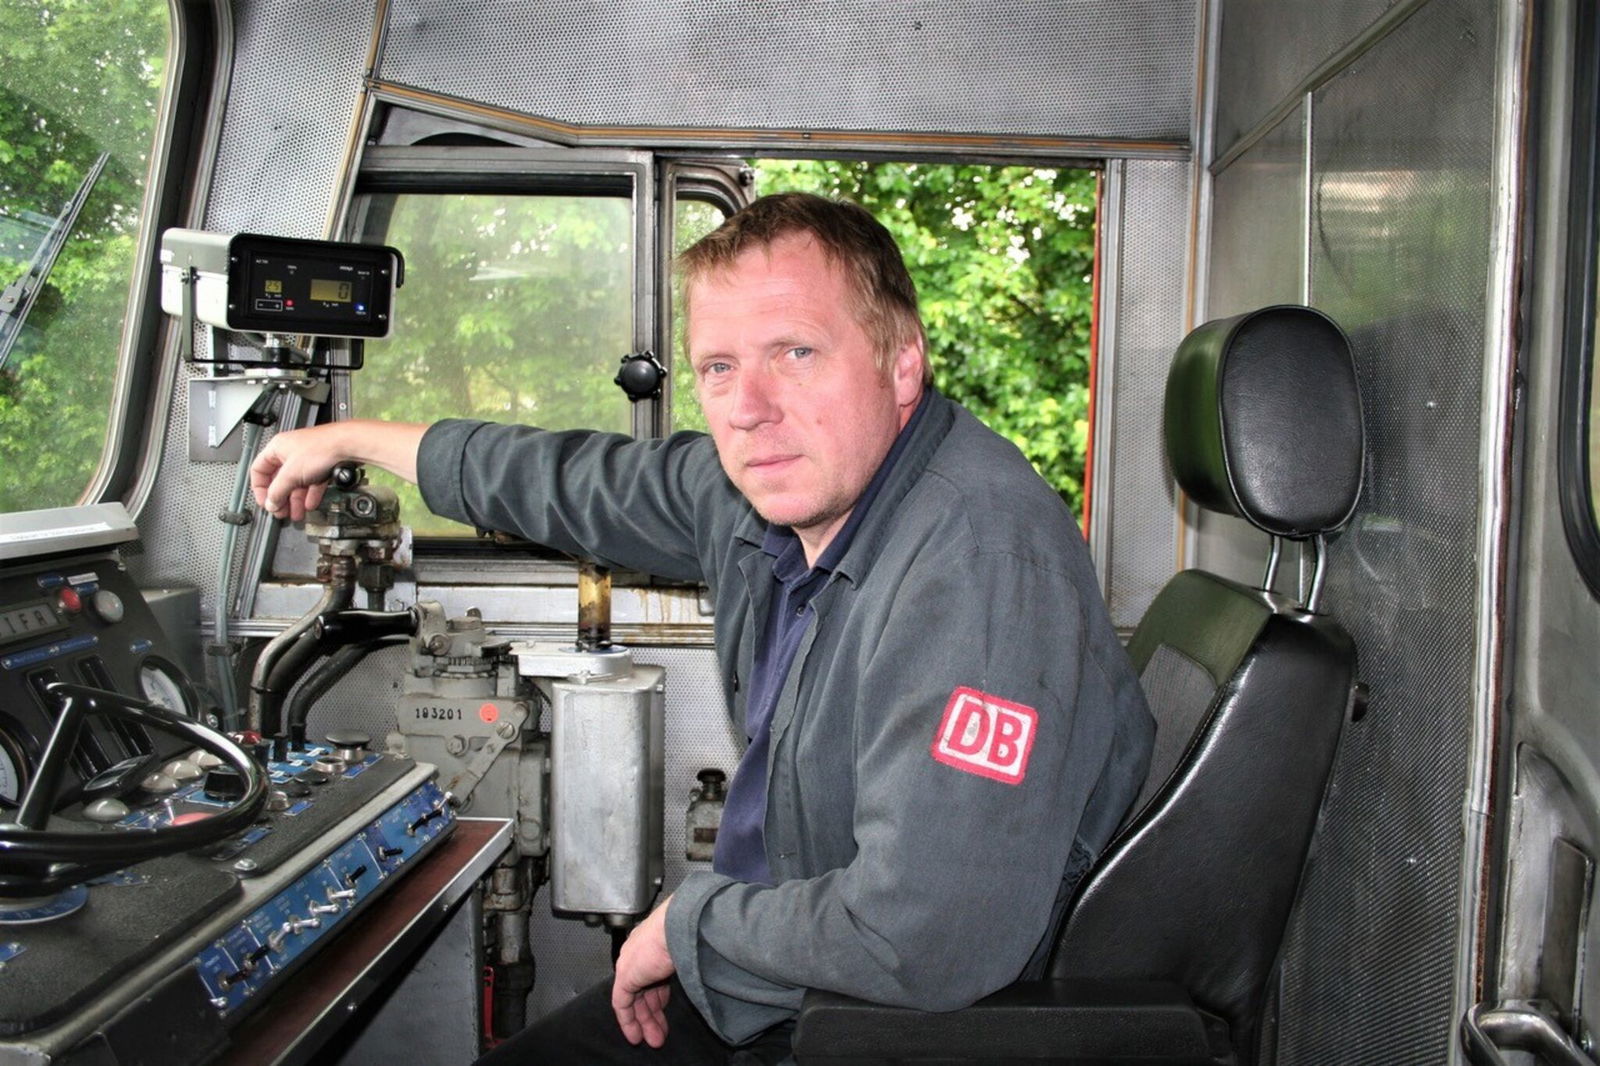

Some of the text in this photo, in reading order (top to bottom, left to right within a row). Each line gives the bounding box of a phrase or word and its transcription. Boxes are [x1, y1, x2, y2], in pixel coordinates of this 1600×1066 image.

[338, 283, 350, 300] 0
[0, 610, 48, 635] IFA
[945, 699, 1024, 768] DB
